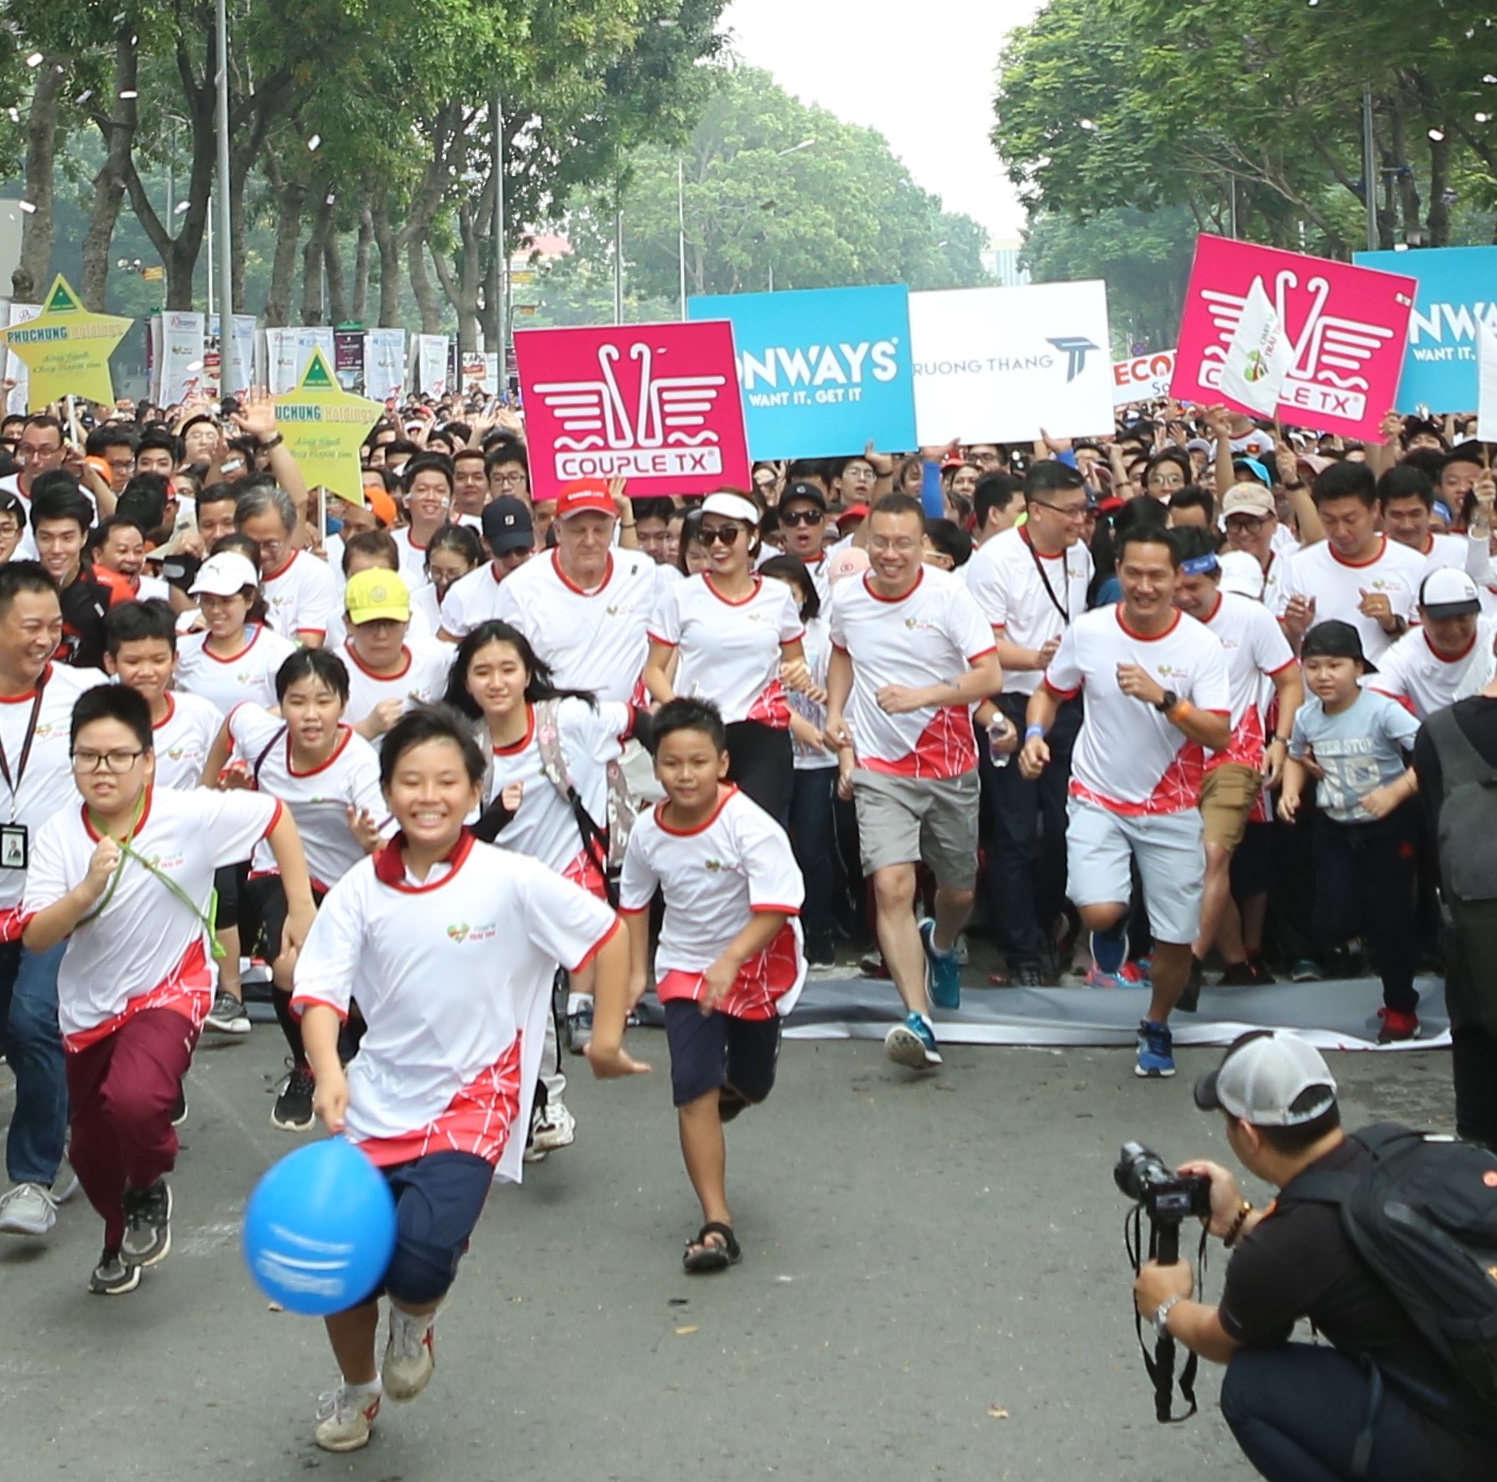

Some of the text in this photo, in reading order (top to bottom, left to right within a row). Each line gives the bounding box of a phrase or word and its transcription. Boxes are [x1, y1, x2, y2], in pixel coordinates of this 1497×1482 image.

[7, 326, 68, 344] PHUCHUNG
[1414, 347, 1454, 361] WANT
[735, 341, 899, 390] NWAYS
[912, 354, 1054, 378] RUONG THANG
[749, 391, 790, 407] WANT
[815, 388, 845, 404] GET
[848, 387, 862, 402] IT
[1319, 391, 1351, 415] TX
[274, 405, 322, 422] UCHUNG
[561, 452, 708, 477] COUPLE TX
